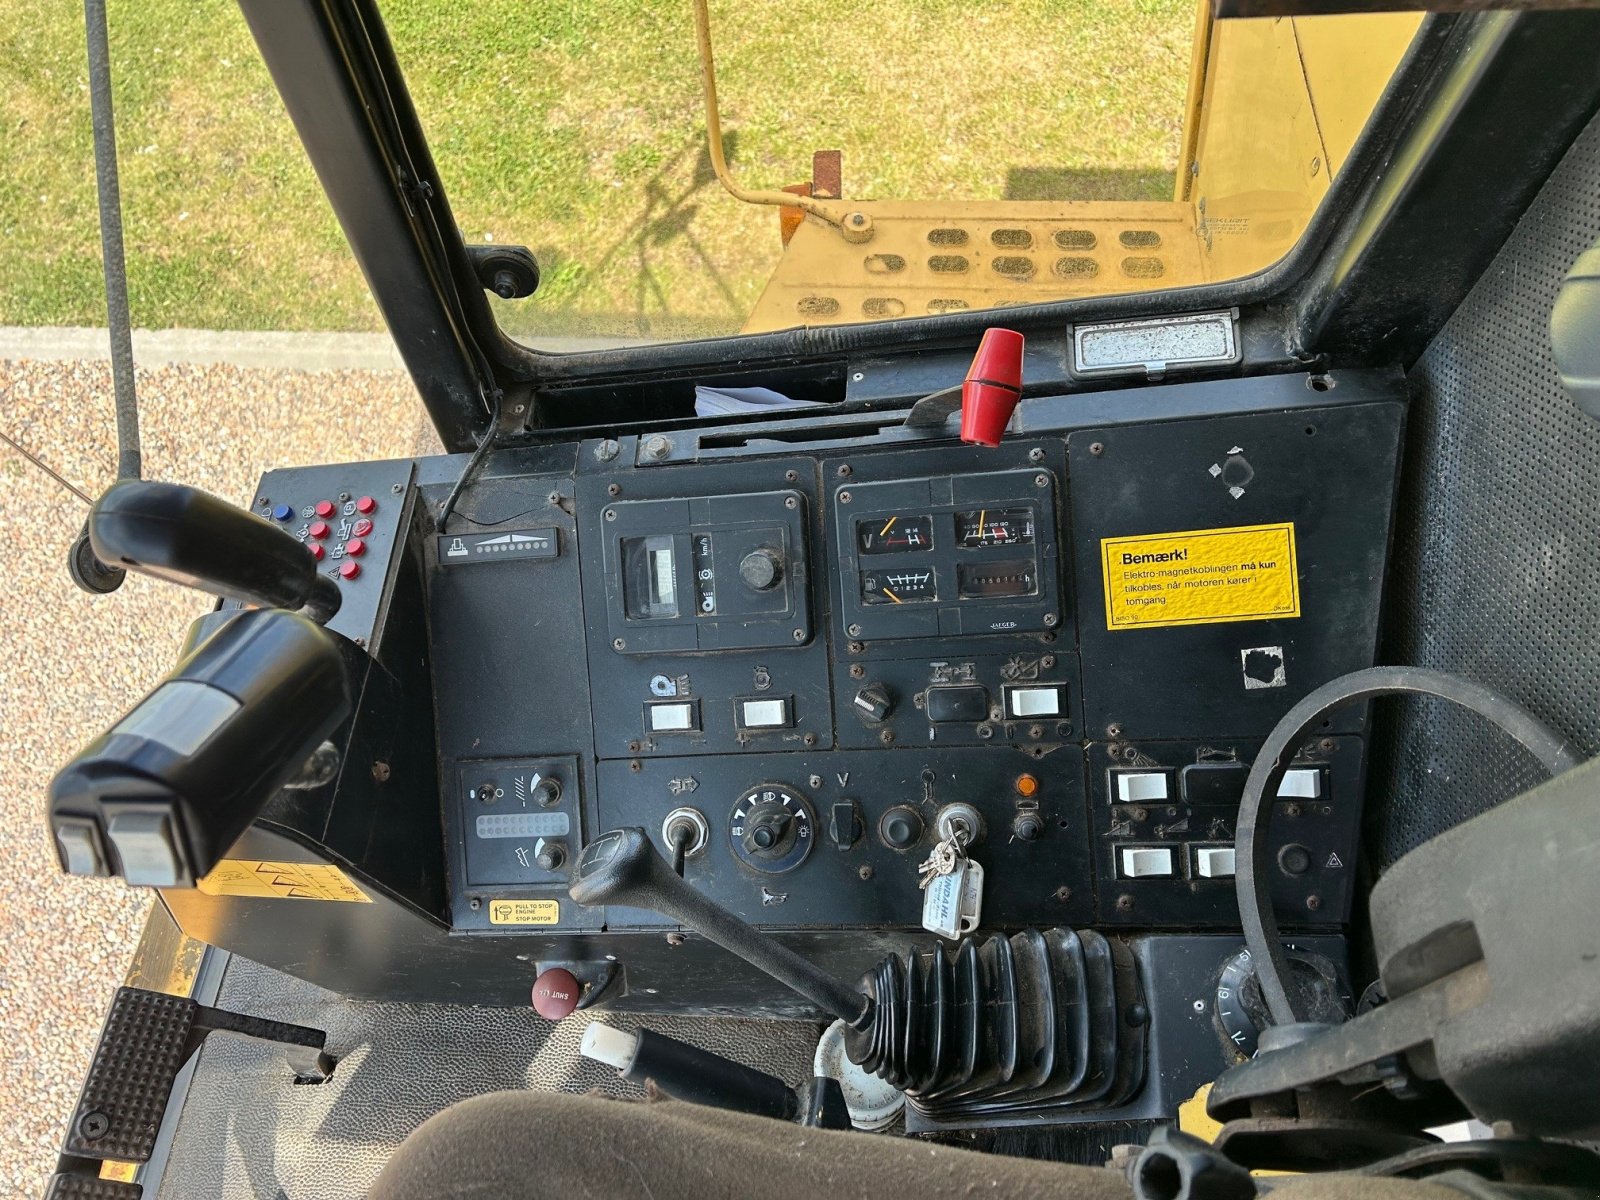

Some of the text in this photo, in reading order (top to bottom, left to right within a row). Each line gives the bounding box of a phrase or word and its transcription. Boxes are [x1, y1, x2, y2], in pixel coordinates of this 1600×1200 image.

[700, 537, 708, 556] km/h
[862, 533, 873, 549] V
[1122, 548, 1188, 565] Bemærk!
[1123, 561, 1277, 580] Elektro-magnetkoblingen må kun
[1167, 581, 1181, 590] når
[1184, 579, 1224, 588] motoren
[1227, 576, 1251, 585] kører
[1126, 596, 1166, 606] tomgang
[551, 991, 569, 1000] SHUT
